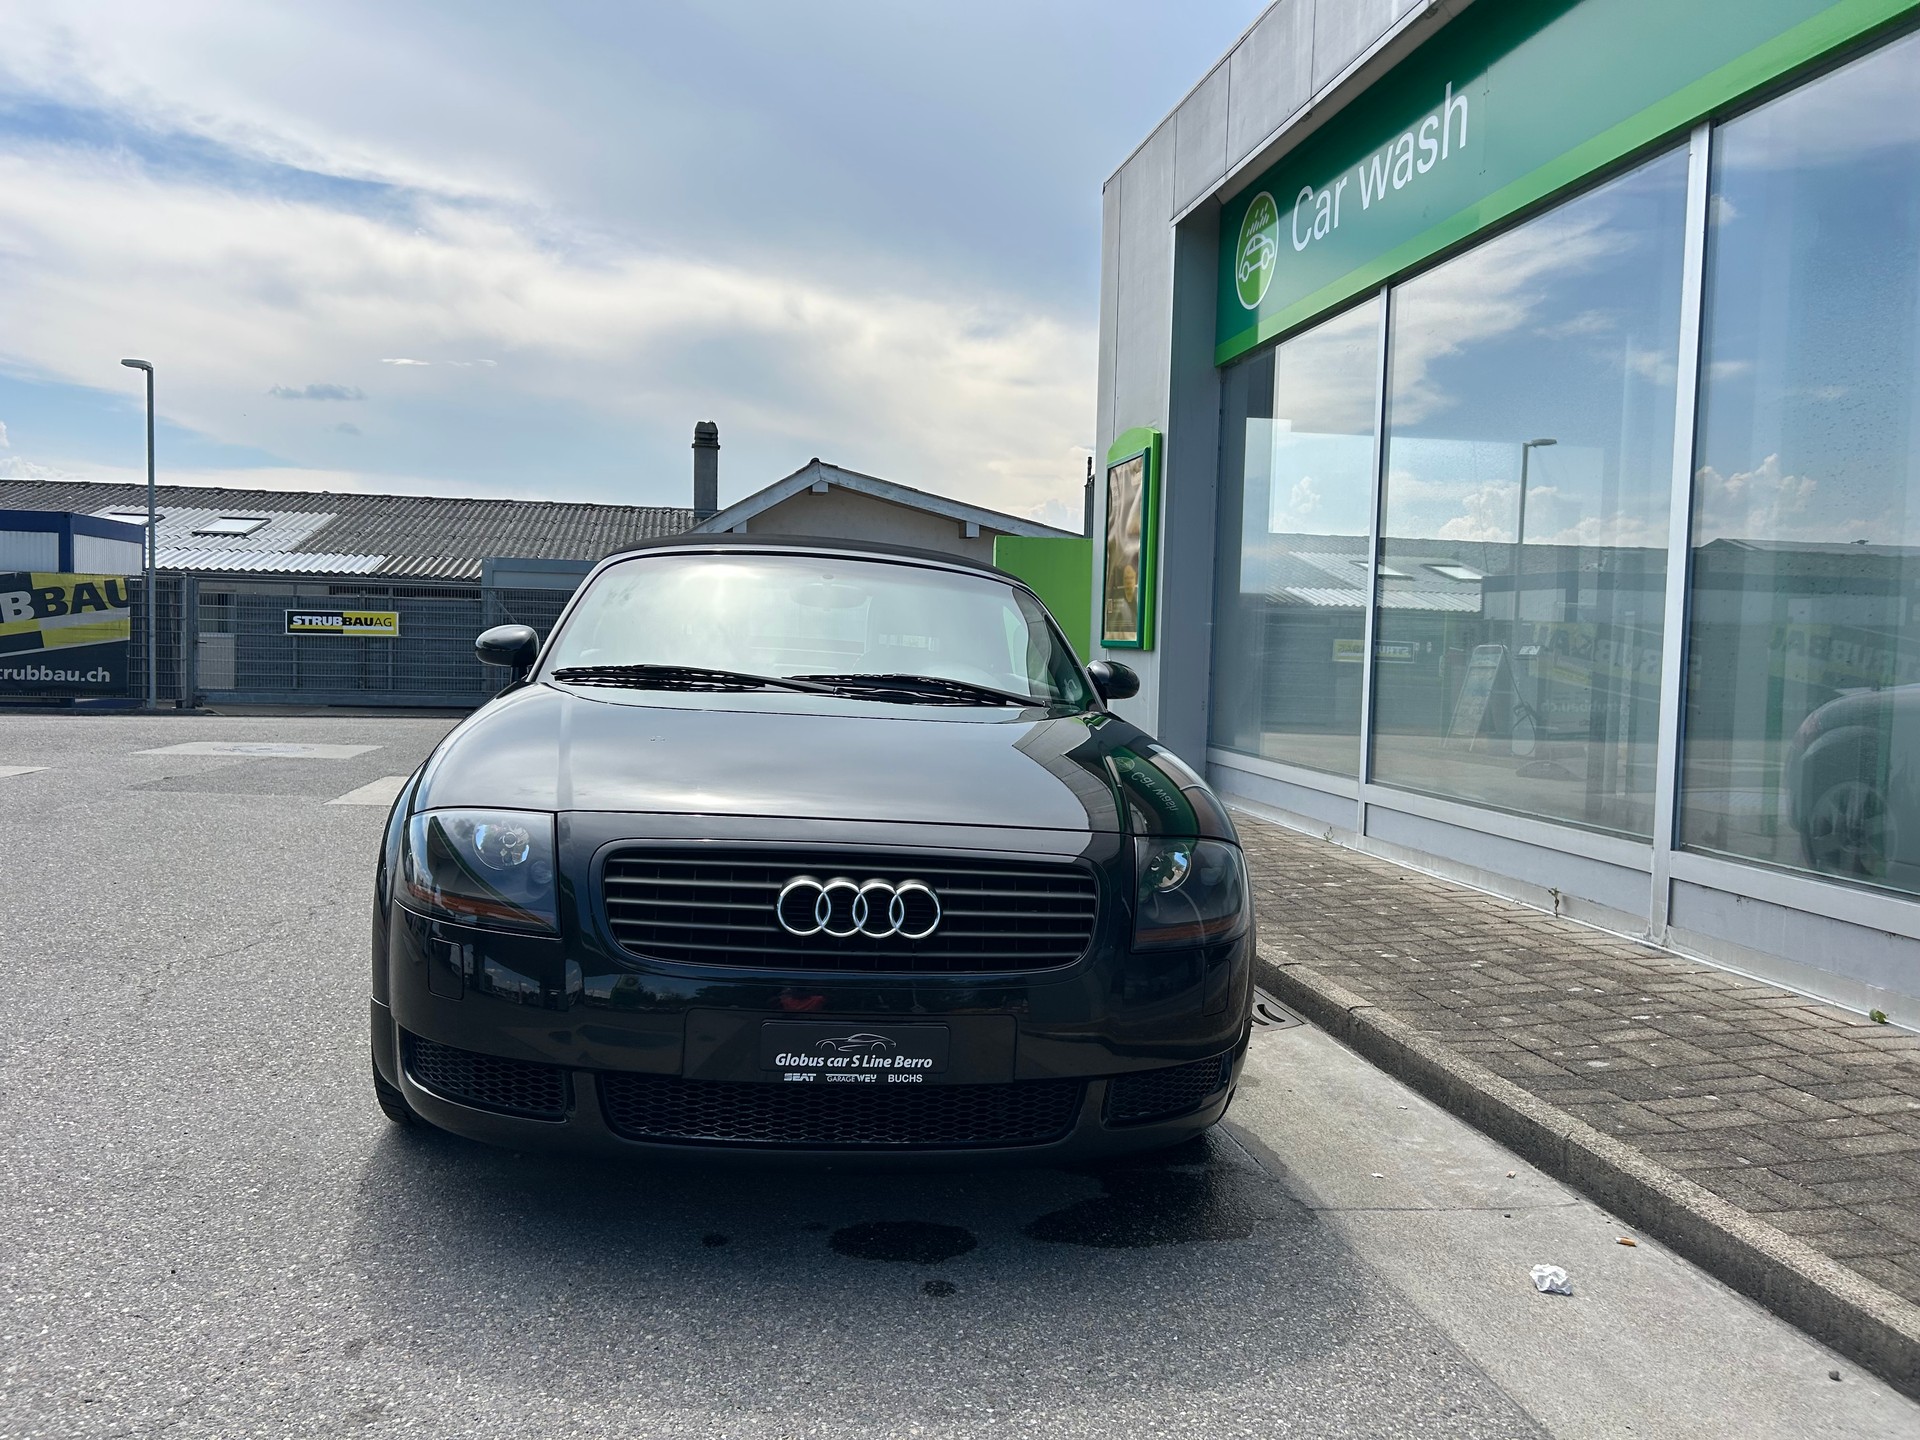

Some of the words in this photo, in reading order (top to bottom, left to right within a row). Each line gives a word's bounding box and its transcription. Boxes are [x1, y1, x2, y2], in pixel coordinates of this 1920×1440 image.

[1292, 176, 1347, 251] Car
[1358, 81, 1468, 211] wash
[775, 1053, 824, 1067] Globus
[826, 1057, 850, 1067] car
[851, 1054, 861, 1068] S
[862, 1054, 892, 1068] Line
[894, 1055, 933, 1068] Berro
[783, 1073, 817, 1082] SEAT
[888, 1074, 923, 1083] BUCHS
